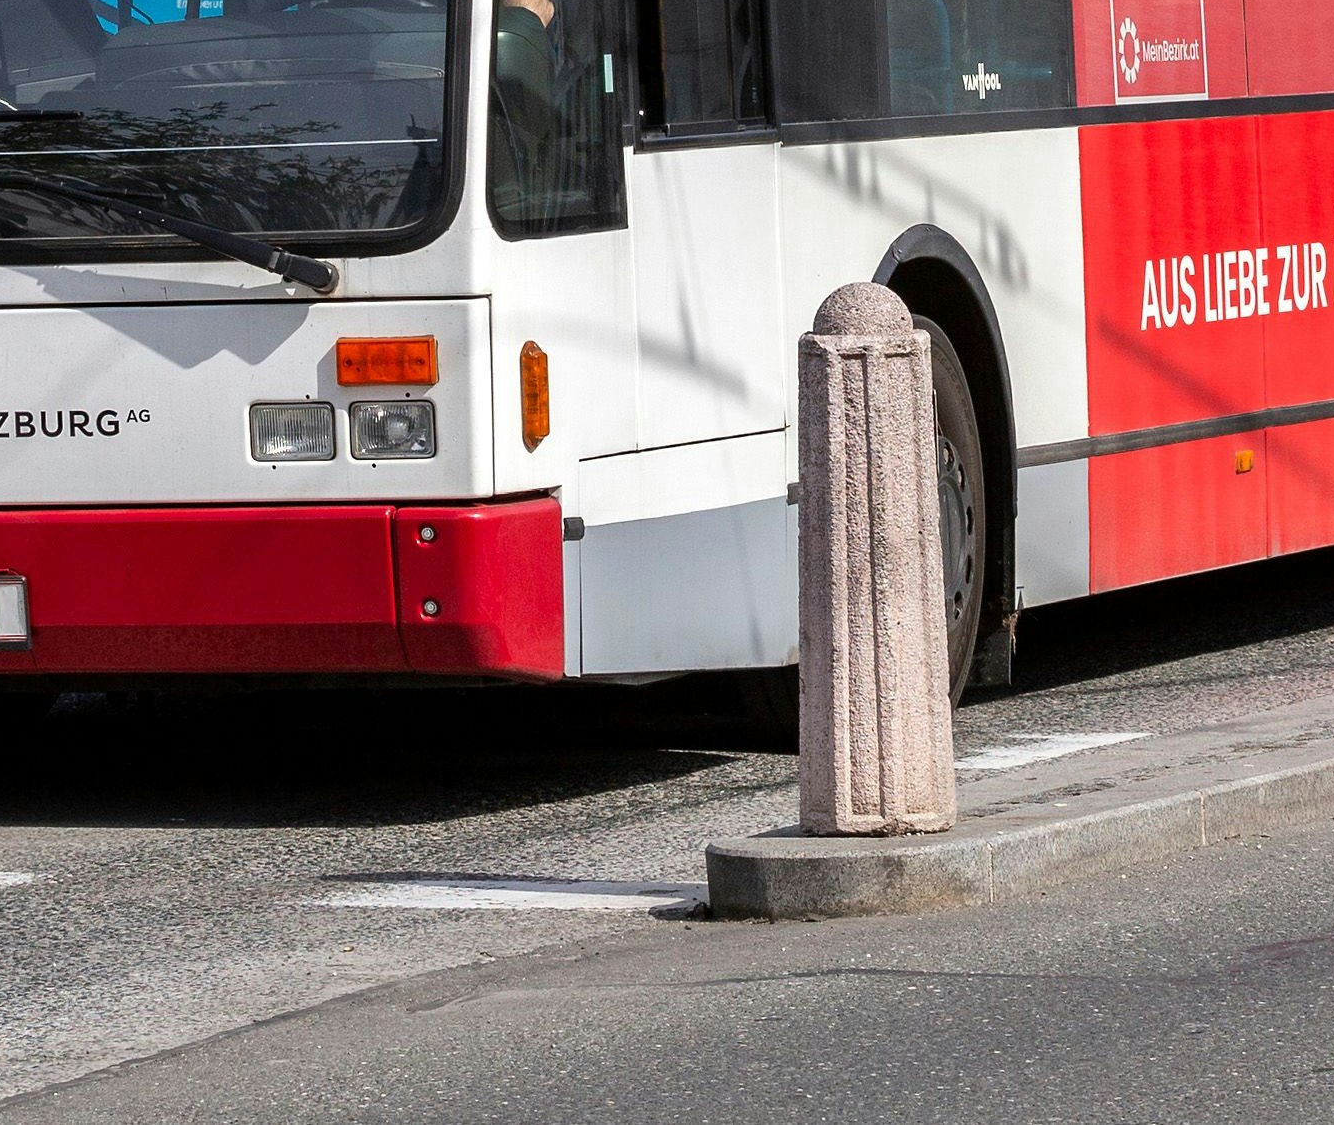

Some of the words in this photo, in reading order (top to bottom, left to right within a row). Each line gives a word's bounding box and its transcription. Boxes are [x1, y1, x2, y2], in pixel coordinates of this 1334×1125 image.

[1142, 39, 1199, 62] MeinBezirk.at
[1140, 255, 1198, 331] AUS
[1203, 247, 1270, 323] LIEBE
[1276, 241, 1328, 313] ZUR
[126, 409, 151, 423] AG
